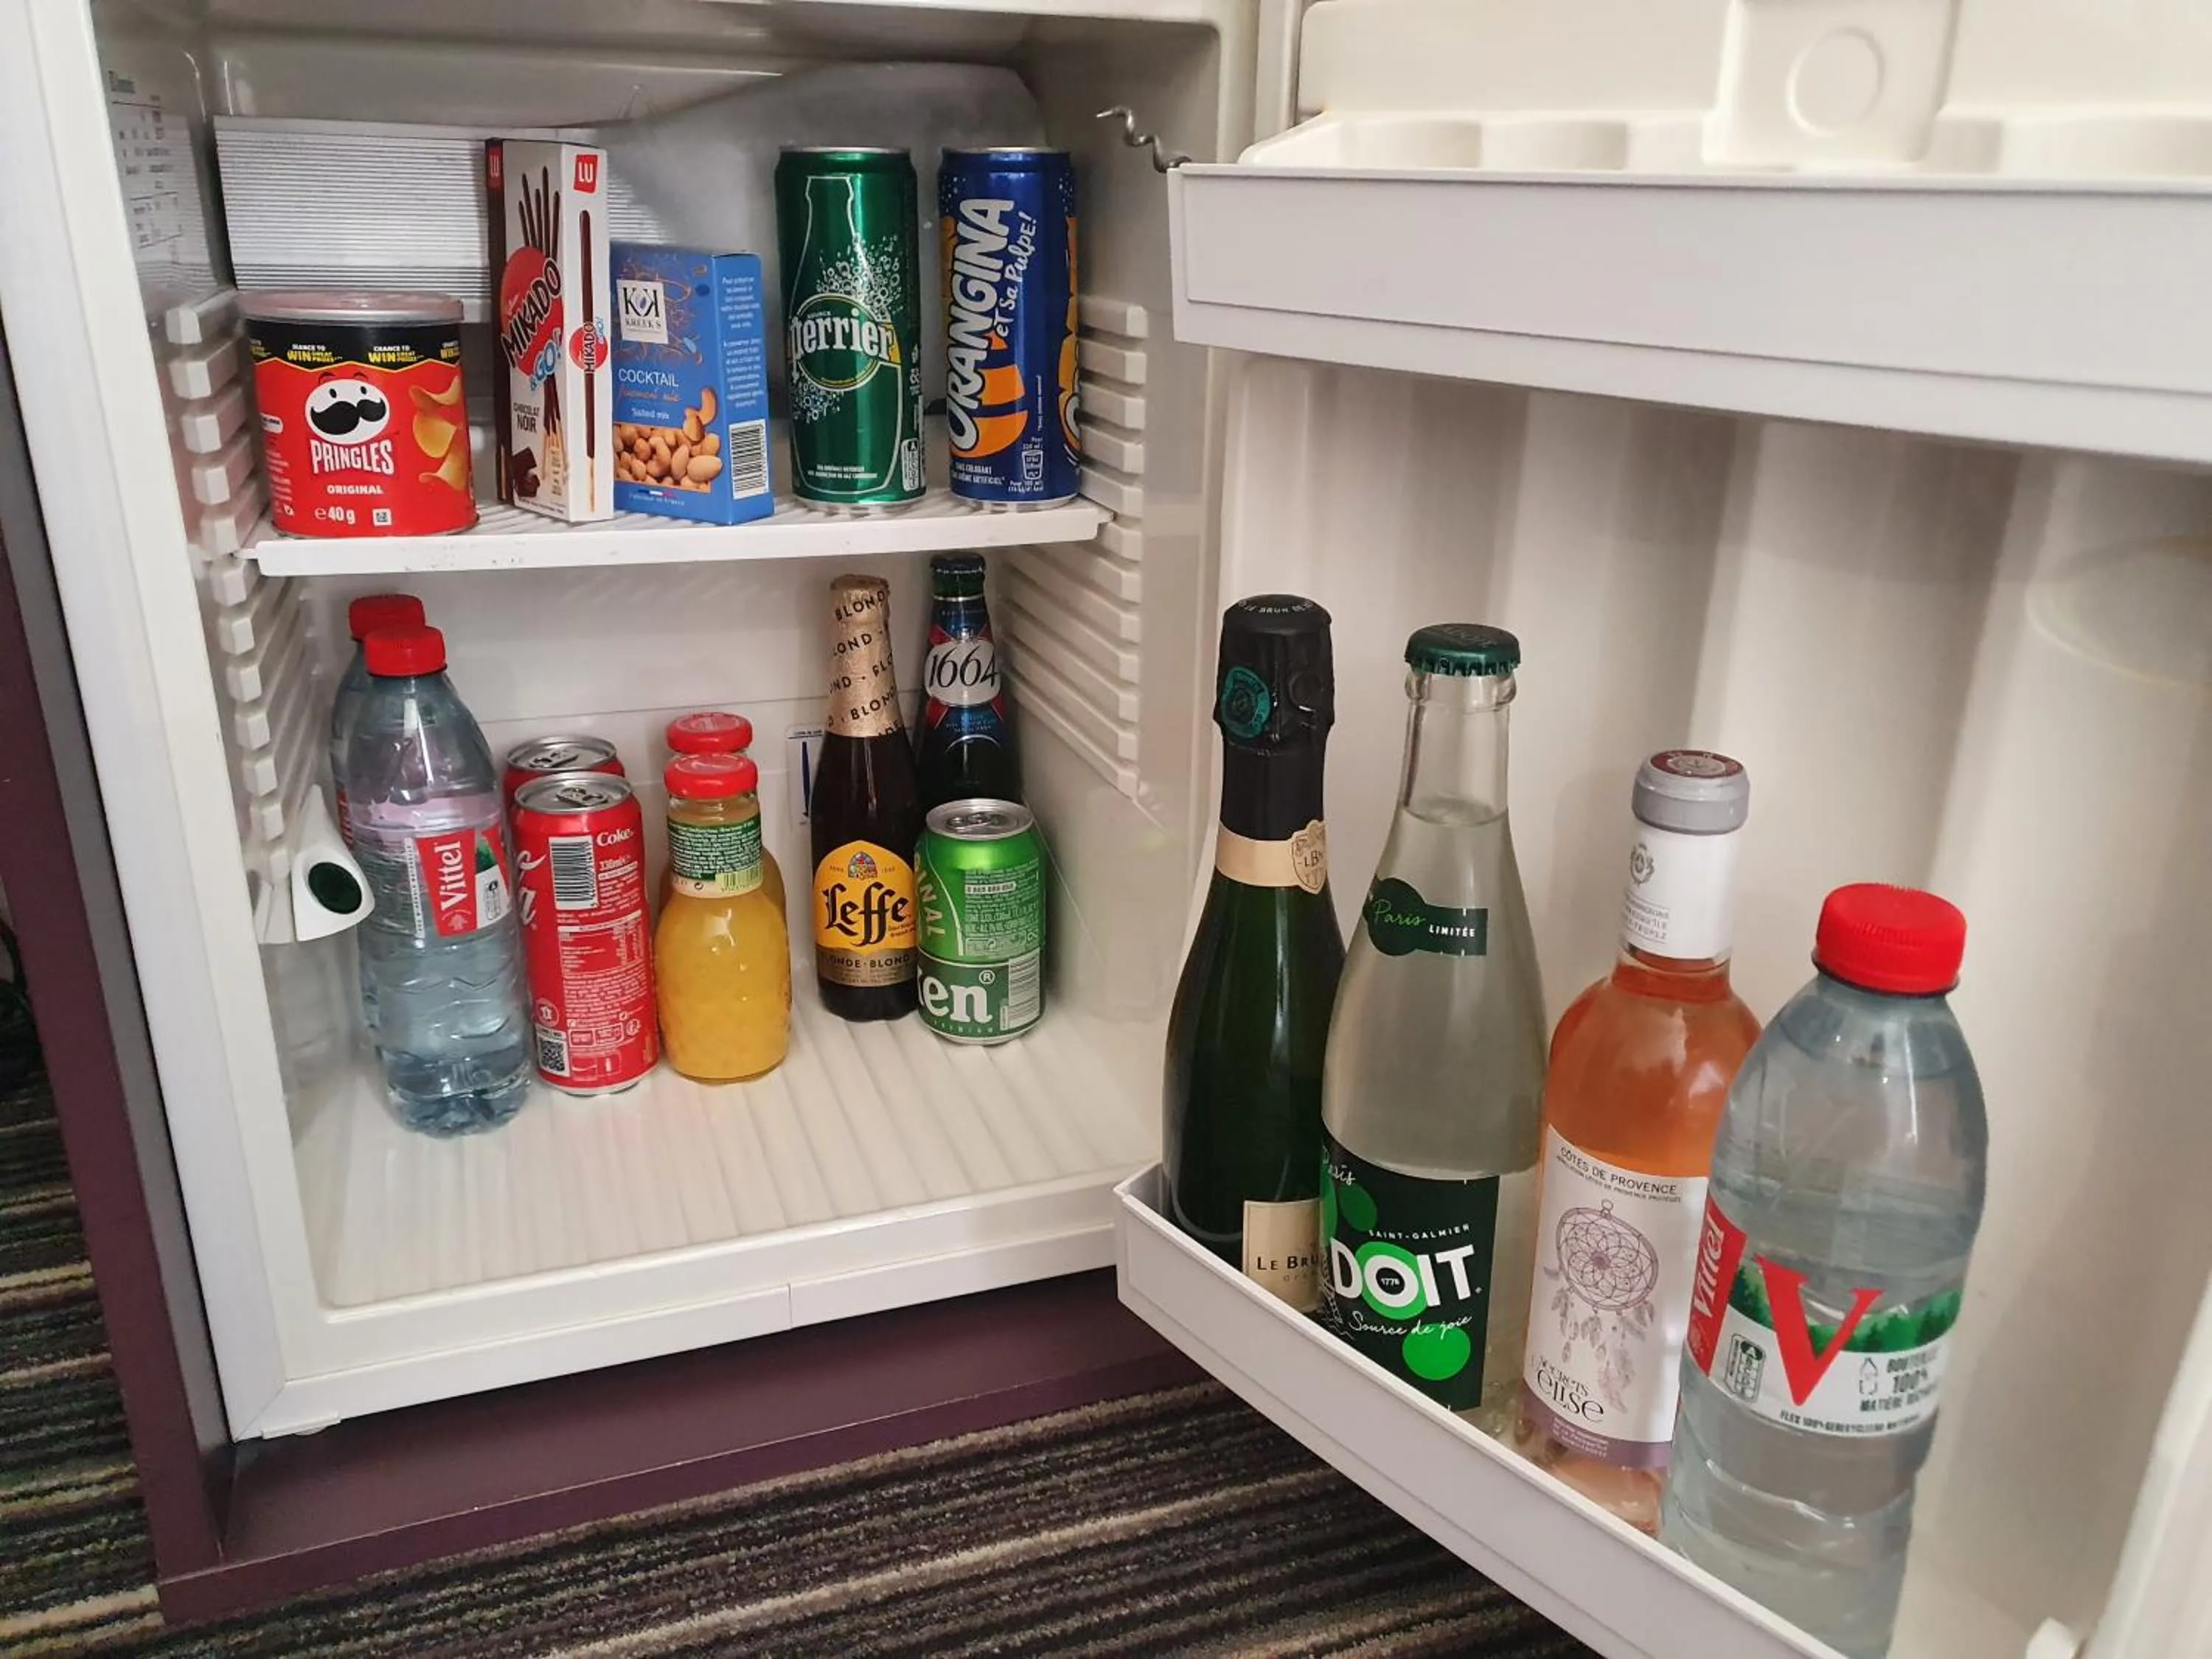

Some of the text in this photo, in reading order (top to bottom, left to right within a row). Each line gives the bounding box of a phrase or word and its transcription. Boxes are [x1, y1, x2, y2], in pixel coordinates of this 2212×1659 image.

[577, 160, 594, 184] LU
[501, 257, 561, 369] MIKADO
[947, 199, 1015, 451] ORANGINA
[287, 350, 311, 362] WIN
[368, 352, 396, 364] WIN
[583, 322, 596, 375] MIKADO
[619, 369, 679, 387] COCKTAIL
[518, 414, 537, 434] NOIR
[310, 439, 394, 475] PRINGLES
[327, 484, 383, 495] ORIGINAL
[835, 590, 885, 621] BLOND
[834, 633, 873, 656] OND
[929, 645, 999, 688] 1664
[597, 828, 632, 847] Coke
[434, 841, 468, 911] Vittel
[822, 881, 910, 947] Leffe
[1374, 899, 1427, 926] Paris
[1429, 923, 1475, 937] LIMITÉE
[869, 953, 910, 968] BLOND
[917, 967, 993, 1024] en
[1560, 1147, 1677, 1195] CÔTES DE PROVENCE
[1368, 1223, 1470, 1239] SAINT-GALMIER
[1287, 1253, 1319, 1270] BRU
[1330, 1237, 1475, 1308] DOIT
[1694, 1211, 1725, 1318] Vittel
[1348, 1310, 1472, 1340] Source de joie
